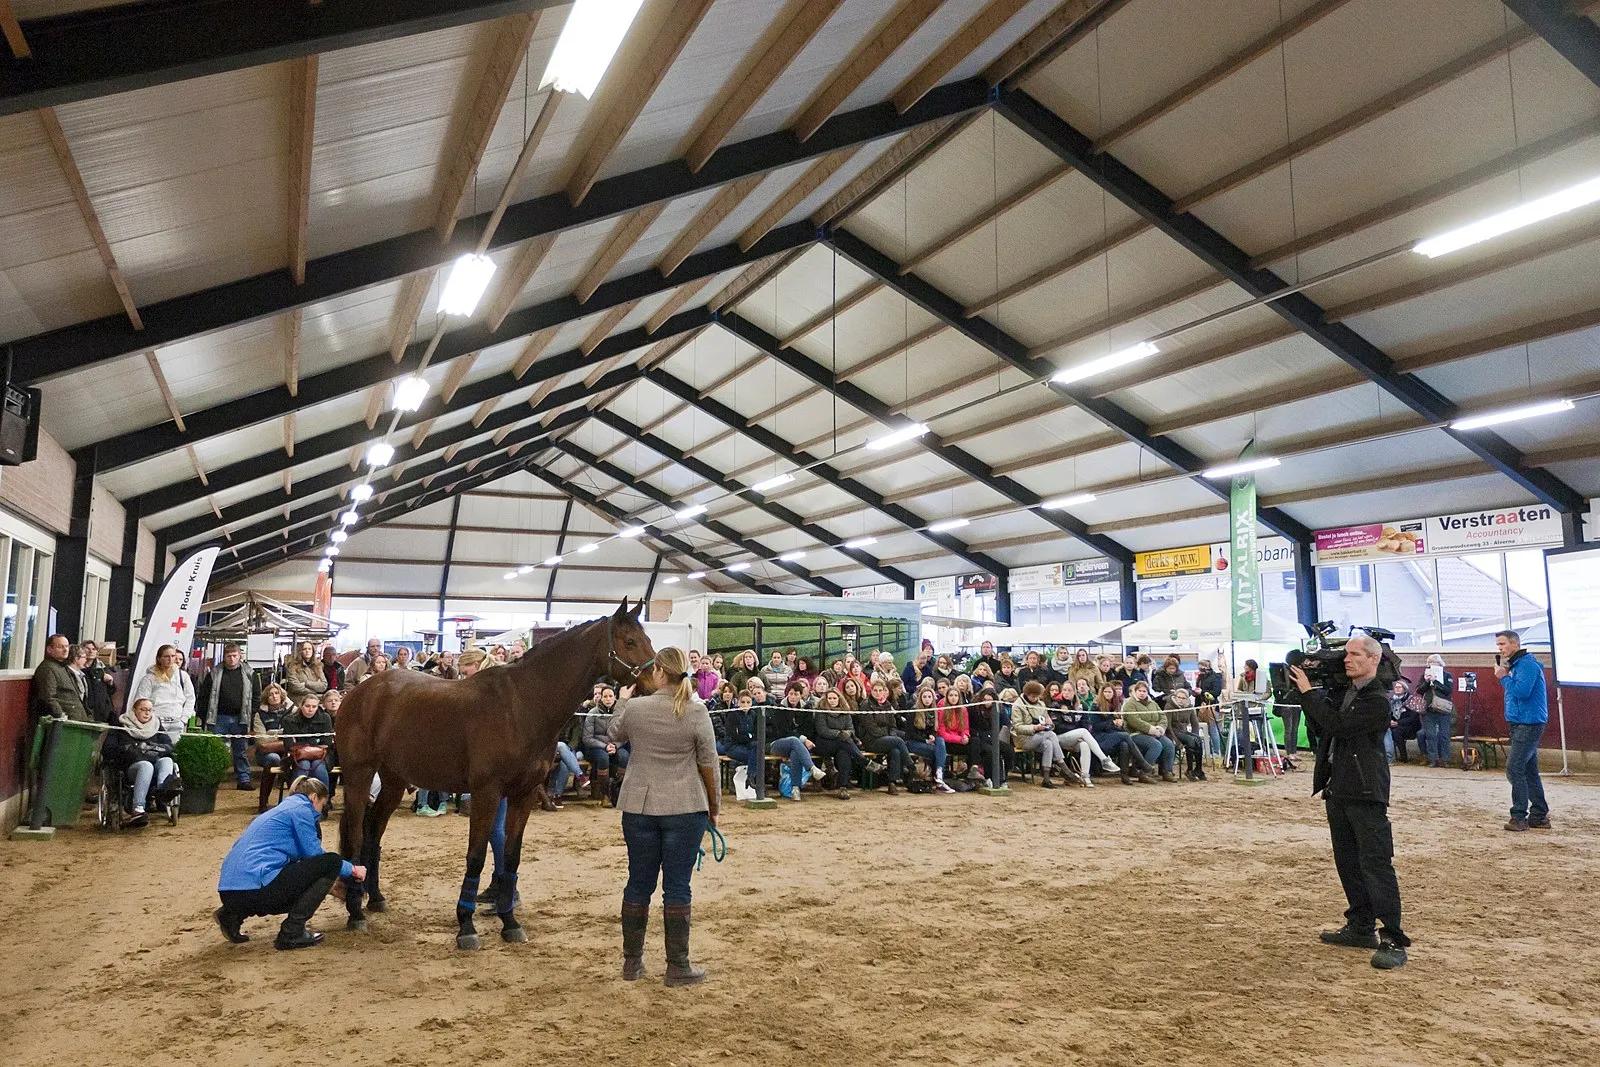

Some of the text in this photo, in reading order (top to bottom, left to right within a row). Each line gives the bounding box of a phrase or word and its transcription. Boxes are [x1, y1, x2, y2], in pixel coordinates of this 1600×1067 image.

[1439, 508, 1551, 531] Verstraaten
[1466, 526, 1524, 539] Accountancy
[1146, 552, 1169, 569] derks
[1236, 511, 1252, 616] VITALRIX
[181, 557, 203, 611] Rode Kruis
